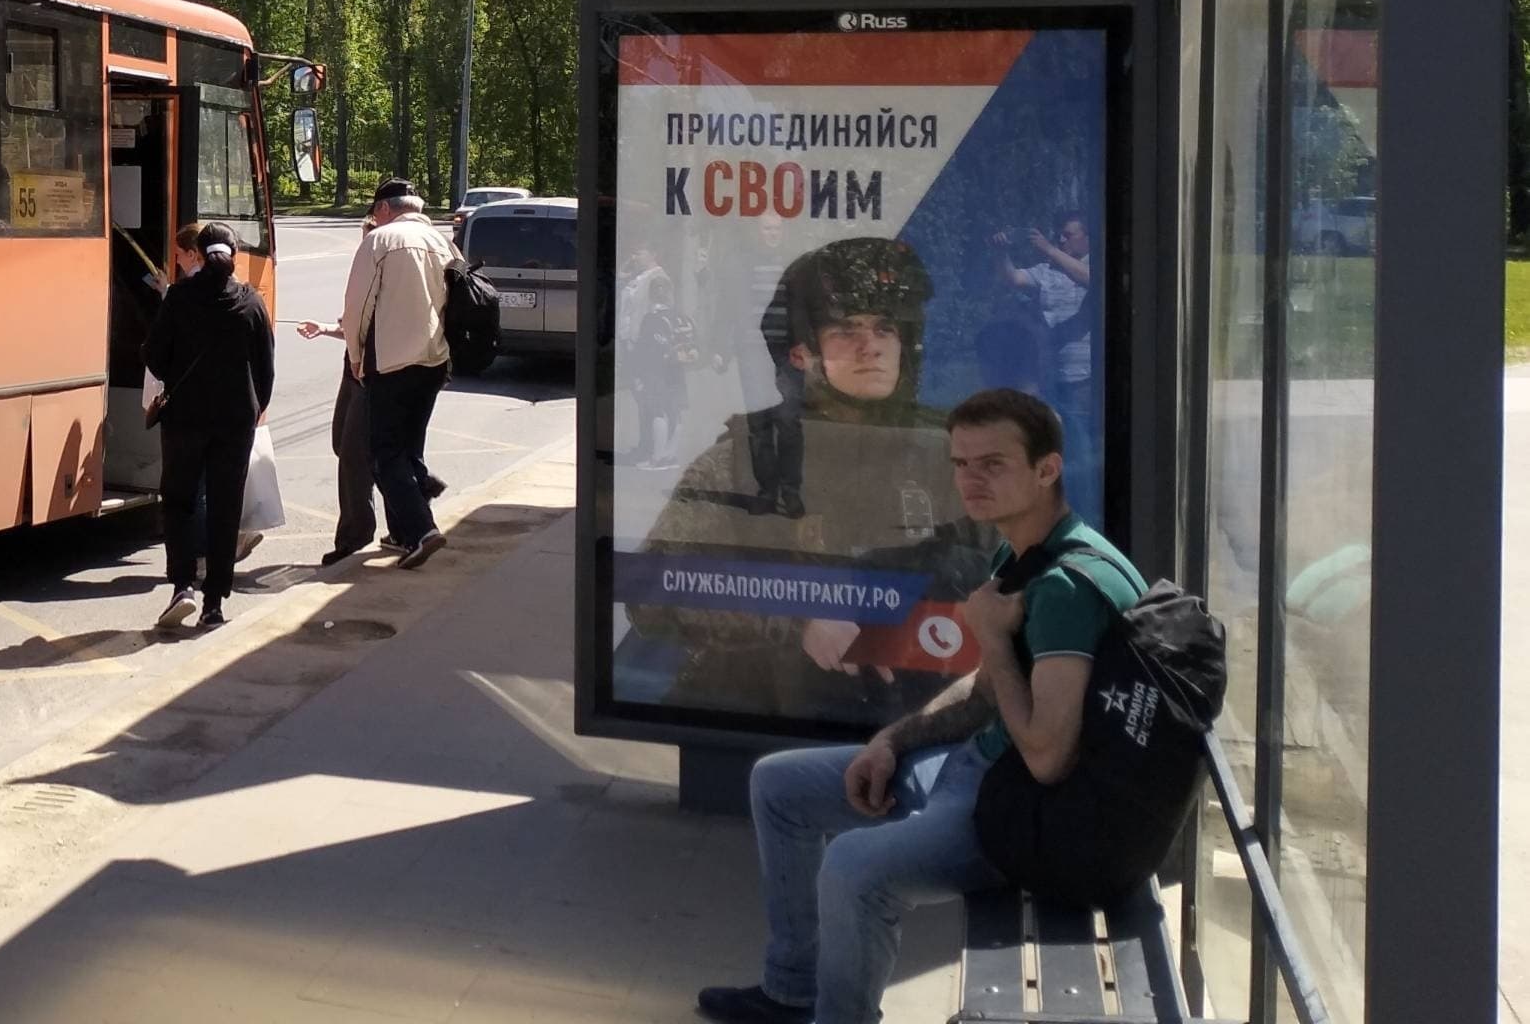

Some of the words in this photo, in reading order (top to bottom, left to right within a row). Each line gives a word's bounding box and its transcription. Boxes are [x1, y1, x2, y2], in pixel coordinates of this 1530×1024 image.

[860, 13, 908, 29] Russ
[666, 107, 937, 150] ПРИСОЕДИНЯЙСЯ
[665, 166, 692, 216] К
[703, 160, 883, 221] СВОИМ
[663, 569, 901, 610] СЛУЖБАПОКОНТРАКТУ.РФ
[1125, 681, 1147, 739] АРМИЯ
[1136, 686, 1159, 747] РССИИ
